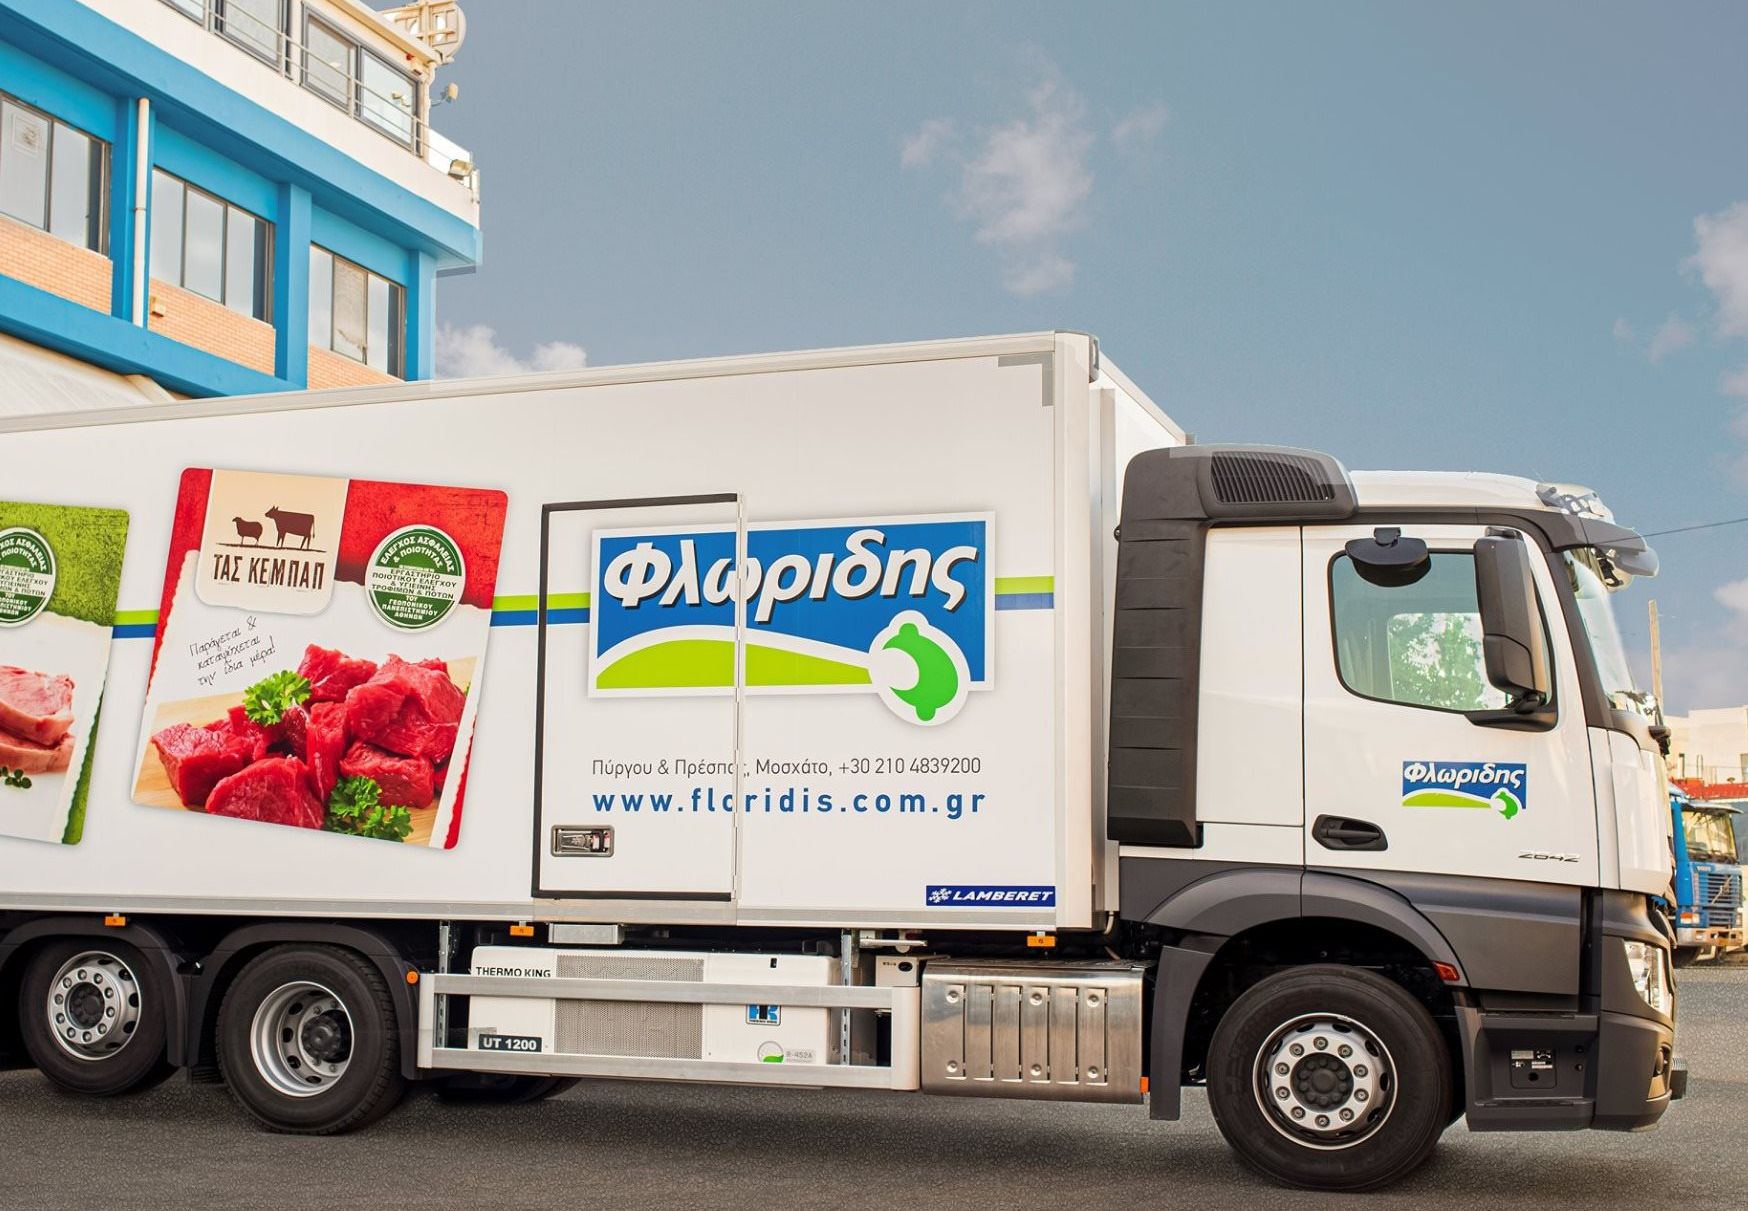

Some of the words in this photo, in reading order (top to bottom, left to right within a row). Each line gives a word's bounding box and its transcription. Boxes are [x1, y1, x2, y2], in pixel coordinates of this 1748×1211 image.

[380, 536, 416, 564] ΕΛΕΓΧΟΣ
[417, 536, 455, 573] ΑΣΦΑΛΕΙΑΣ
[400, 546, 443, 569] ΠΟΙΟΤΗΤΑΣ
[213, 553, 243, 582] ΤΑΣ
[248, 557, 325, 590] ΚΕΜΠΑΠ
[372, 572, 417, 583] ΠΟΙΟΤΙΚΟΥ
[420, 578, 457, 588] ΕΛΕΓΧΟΥ
[391, 568, 440, 580] ΕΡΓΑΣΤΗΡΙΟ
[603, 529, 979, 623] Φλωριδης
[425, 590, 454, 600] ΠΟΤΩΝ
[189, 628, 242, 657] Παράγεται
[246, 615, 257, 631] &
[592, 759, 653, 779] Πύργου
[657, 759, 670, 776] &
[756, 758, 833, 777] Μοσχάτο,
[839, 757, 870, 775] +30
[875, 757, 905, 774] 210
[909, 756, 981, 774] 4839200
[1403, 762, 1524, 789] Φλωριδης
[952, 890, 1054, 902] LAMBERET
[475, 966, 522, 977] THERMO
[524, 968, 551, 978] KING
[483, 1037, 502, 1049] UT
[505, 1038, 537, 1051] 1200
